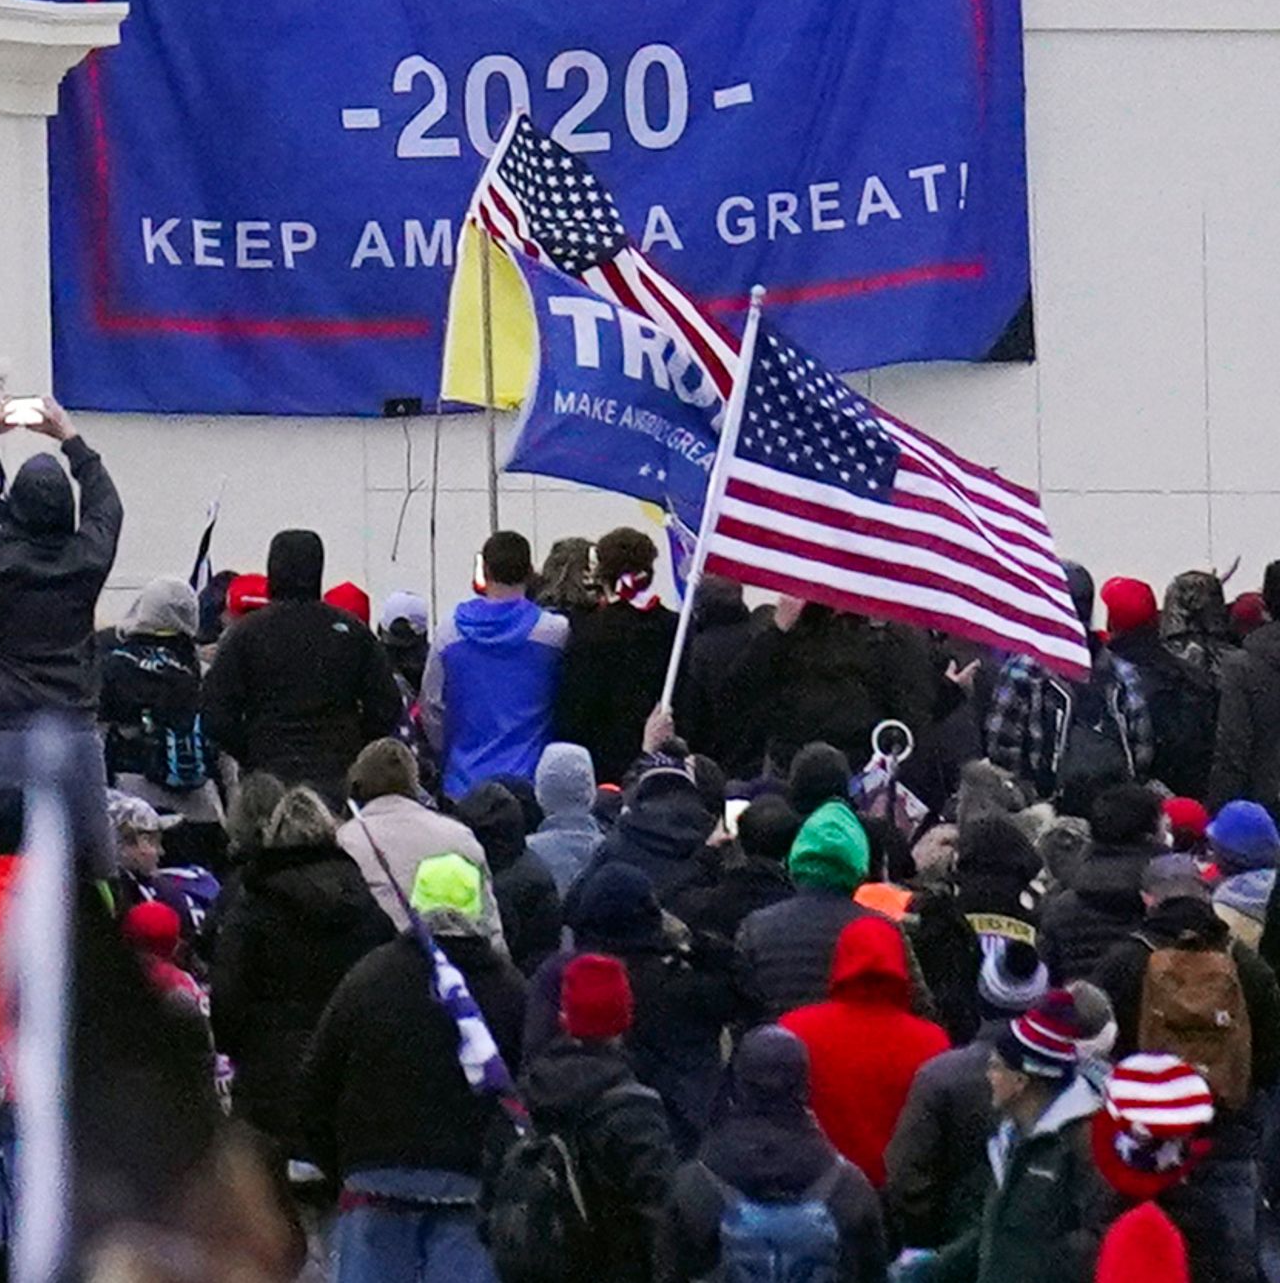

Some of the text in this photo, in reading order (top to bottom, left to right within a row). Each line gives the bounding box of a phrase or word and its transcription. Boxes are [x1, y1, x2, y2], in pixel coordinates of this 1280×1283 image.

[141, 216, 317, 270] KEEP
[717, 161, 970, 245] GREAT!
[553, 389, 618, 425] MAKE
[667, 426, 717, 472] GREA
